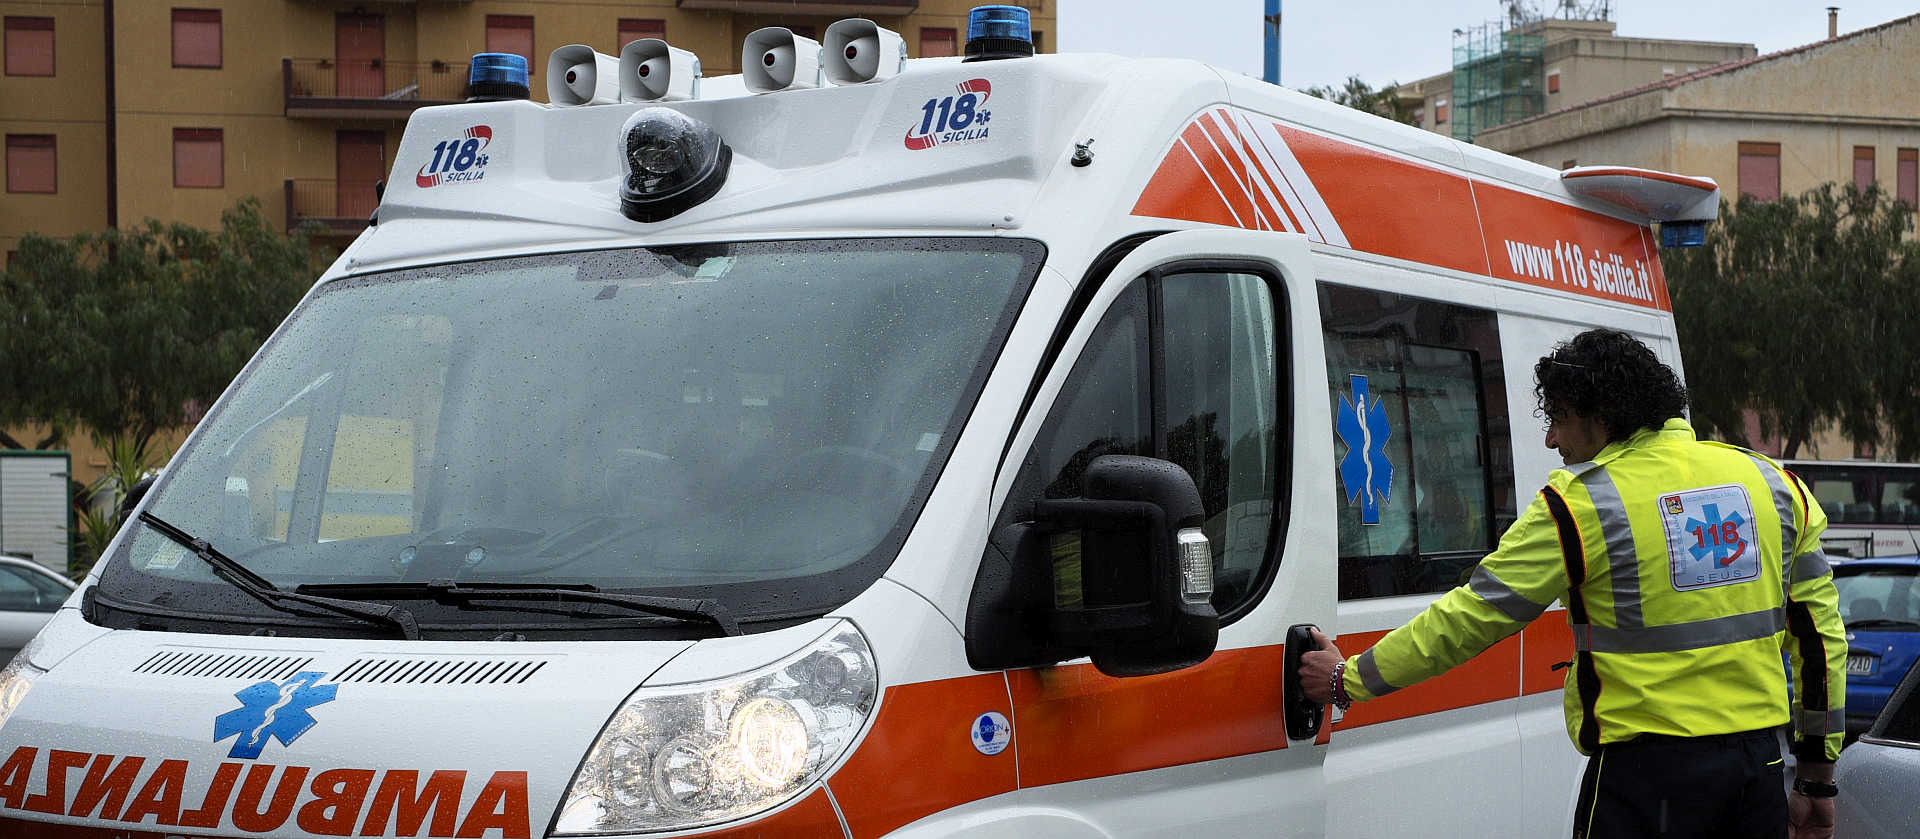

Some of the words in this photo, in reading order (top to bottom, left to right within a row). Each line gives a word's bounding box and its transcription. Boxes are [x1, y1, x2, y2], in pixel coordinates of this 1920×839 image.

[919, 93, 977, 135] 118
[941, 127, 989, 143] SICILIA
[428, 138, 480, 174] 118
[445, 171, 485, 183] SICILIA
[1692, 521, 1739, 549] 118
[1695, 569, 1743, 584] SEUS
